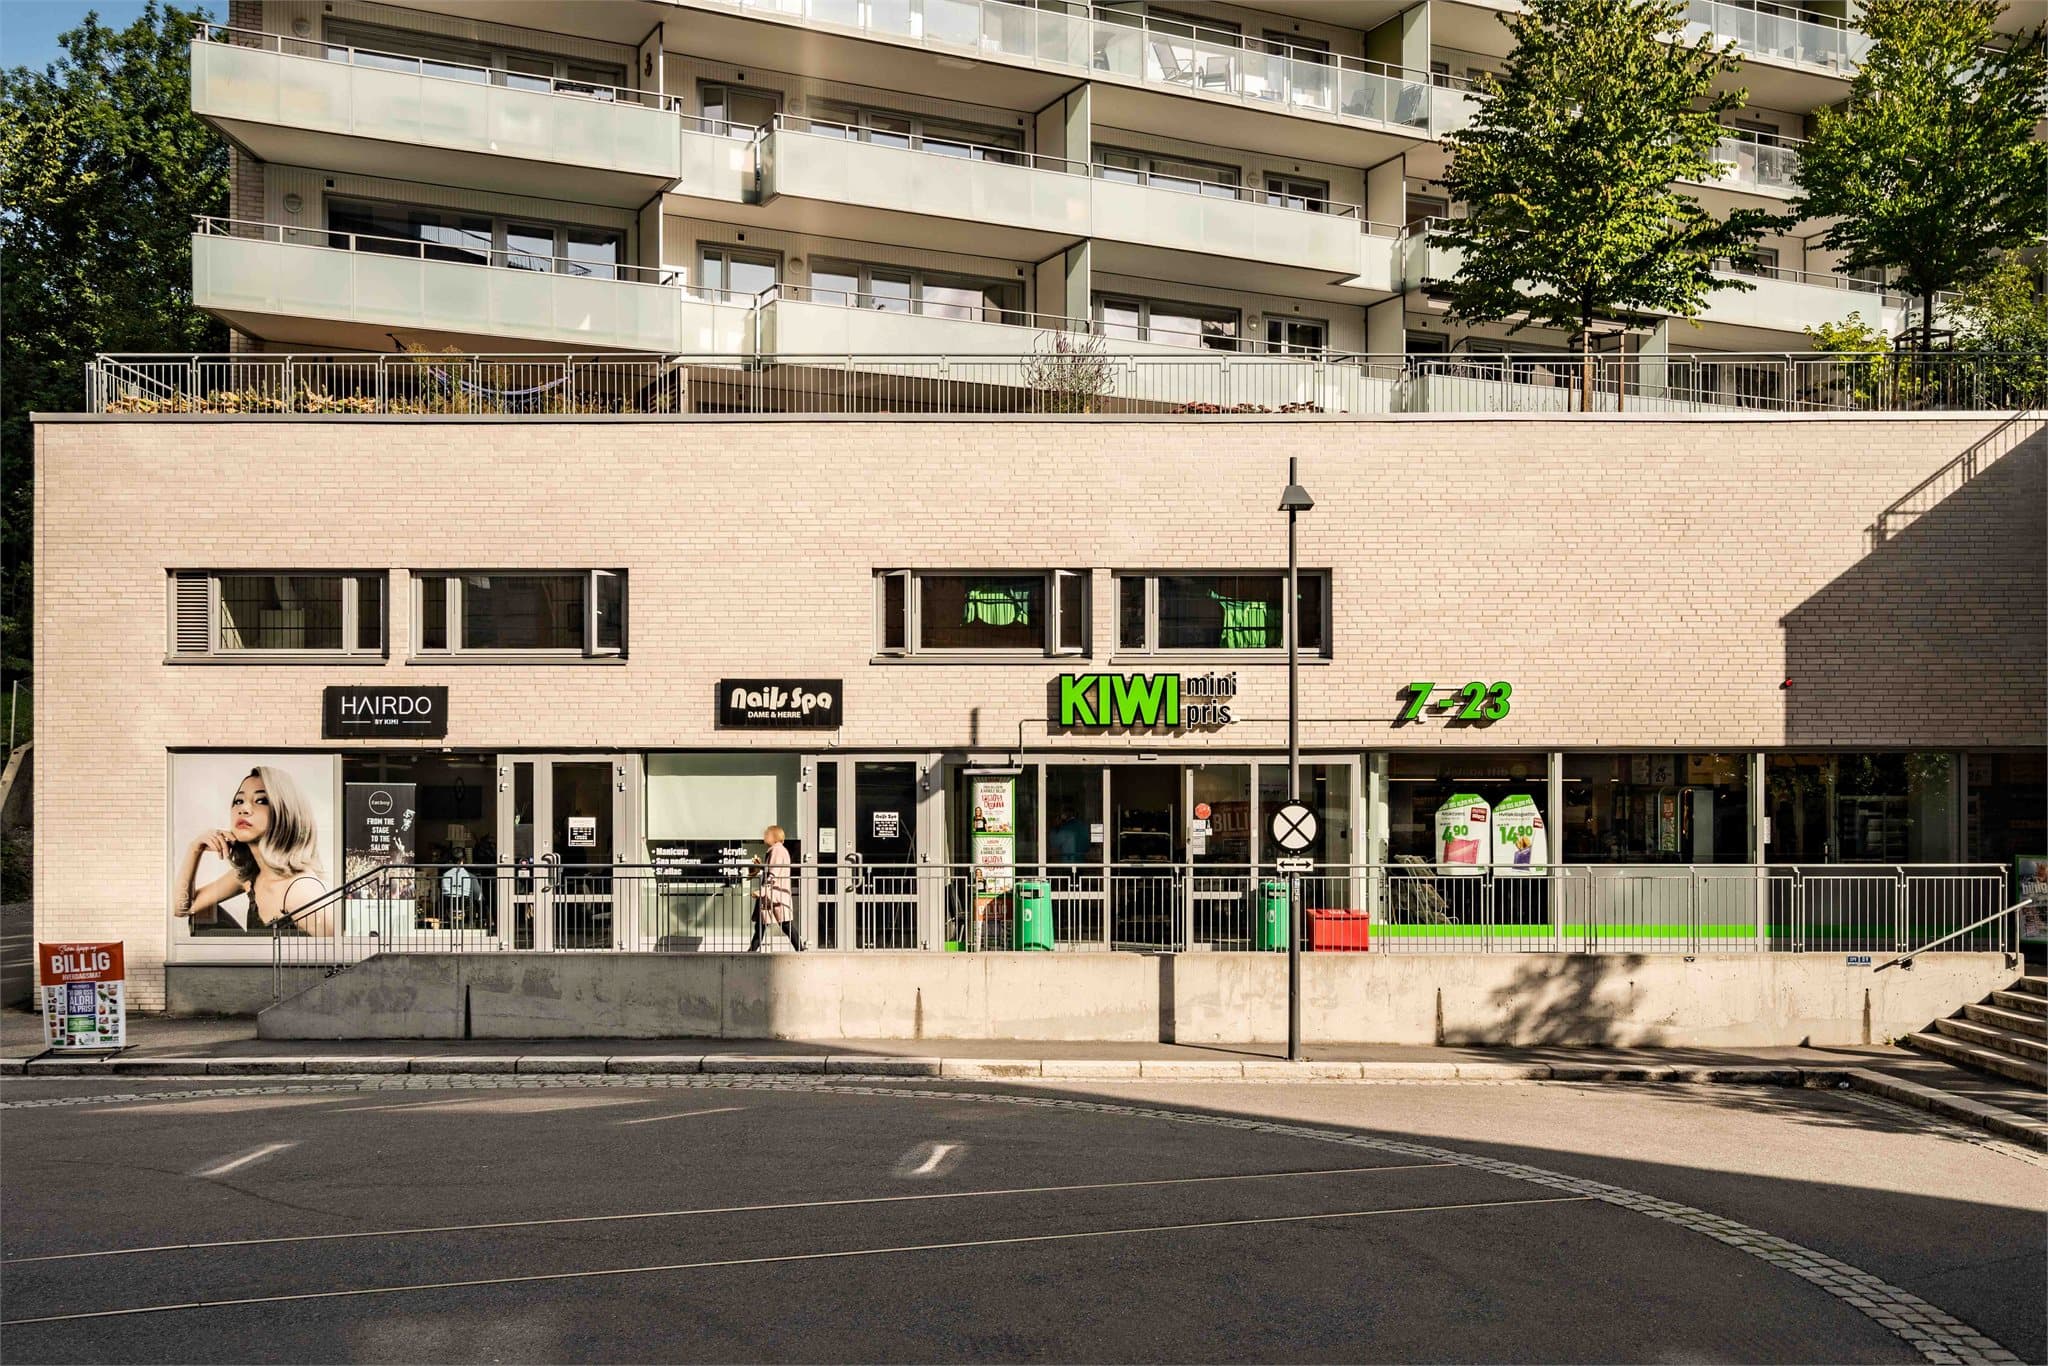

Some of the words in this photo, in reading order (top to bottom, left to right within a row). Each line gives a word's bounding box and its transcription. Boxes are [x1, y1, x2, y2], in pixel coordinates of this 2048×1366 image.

[341, 696, 432, 715] HAIRDO
[730, 686, 788, 710] Nails
[791, 687, 833, 715] Spa
[1059, 674, 1180, 727] KIWI
[1186, 671, 1237, 697] mini
[1186, 699, 1232, 729] pris
[371, 826, 389, 834] STAGE
[380, 835, 390, 843] THE
[656, 848, 688, 856] Manicure
[723, 848, 747, 856] Acrylic
[51, 952, 111, 974] BILLIG
[69, 995, 93, 1006] ALDRI
